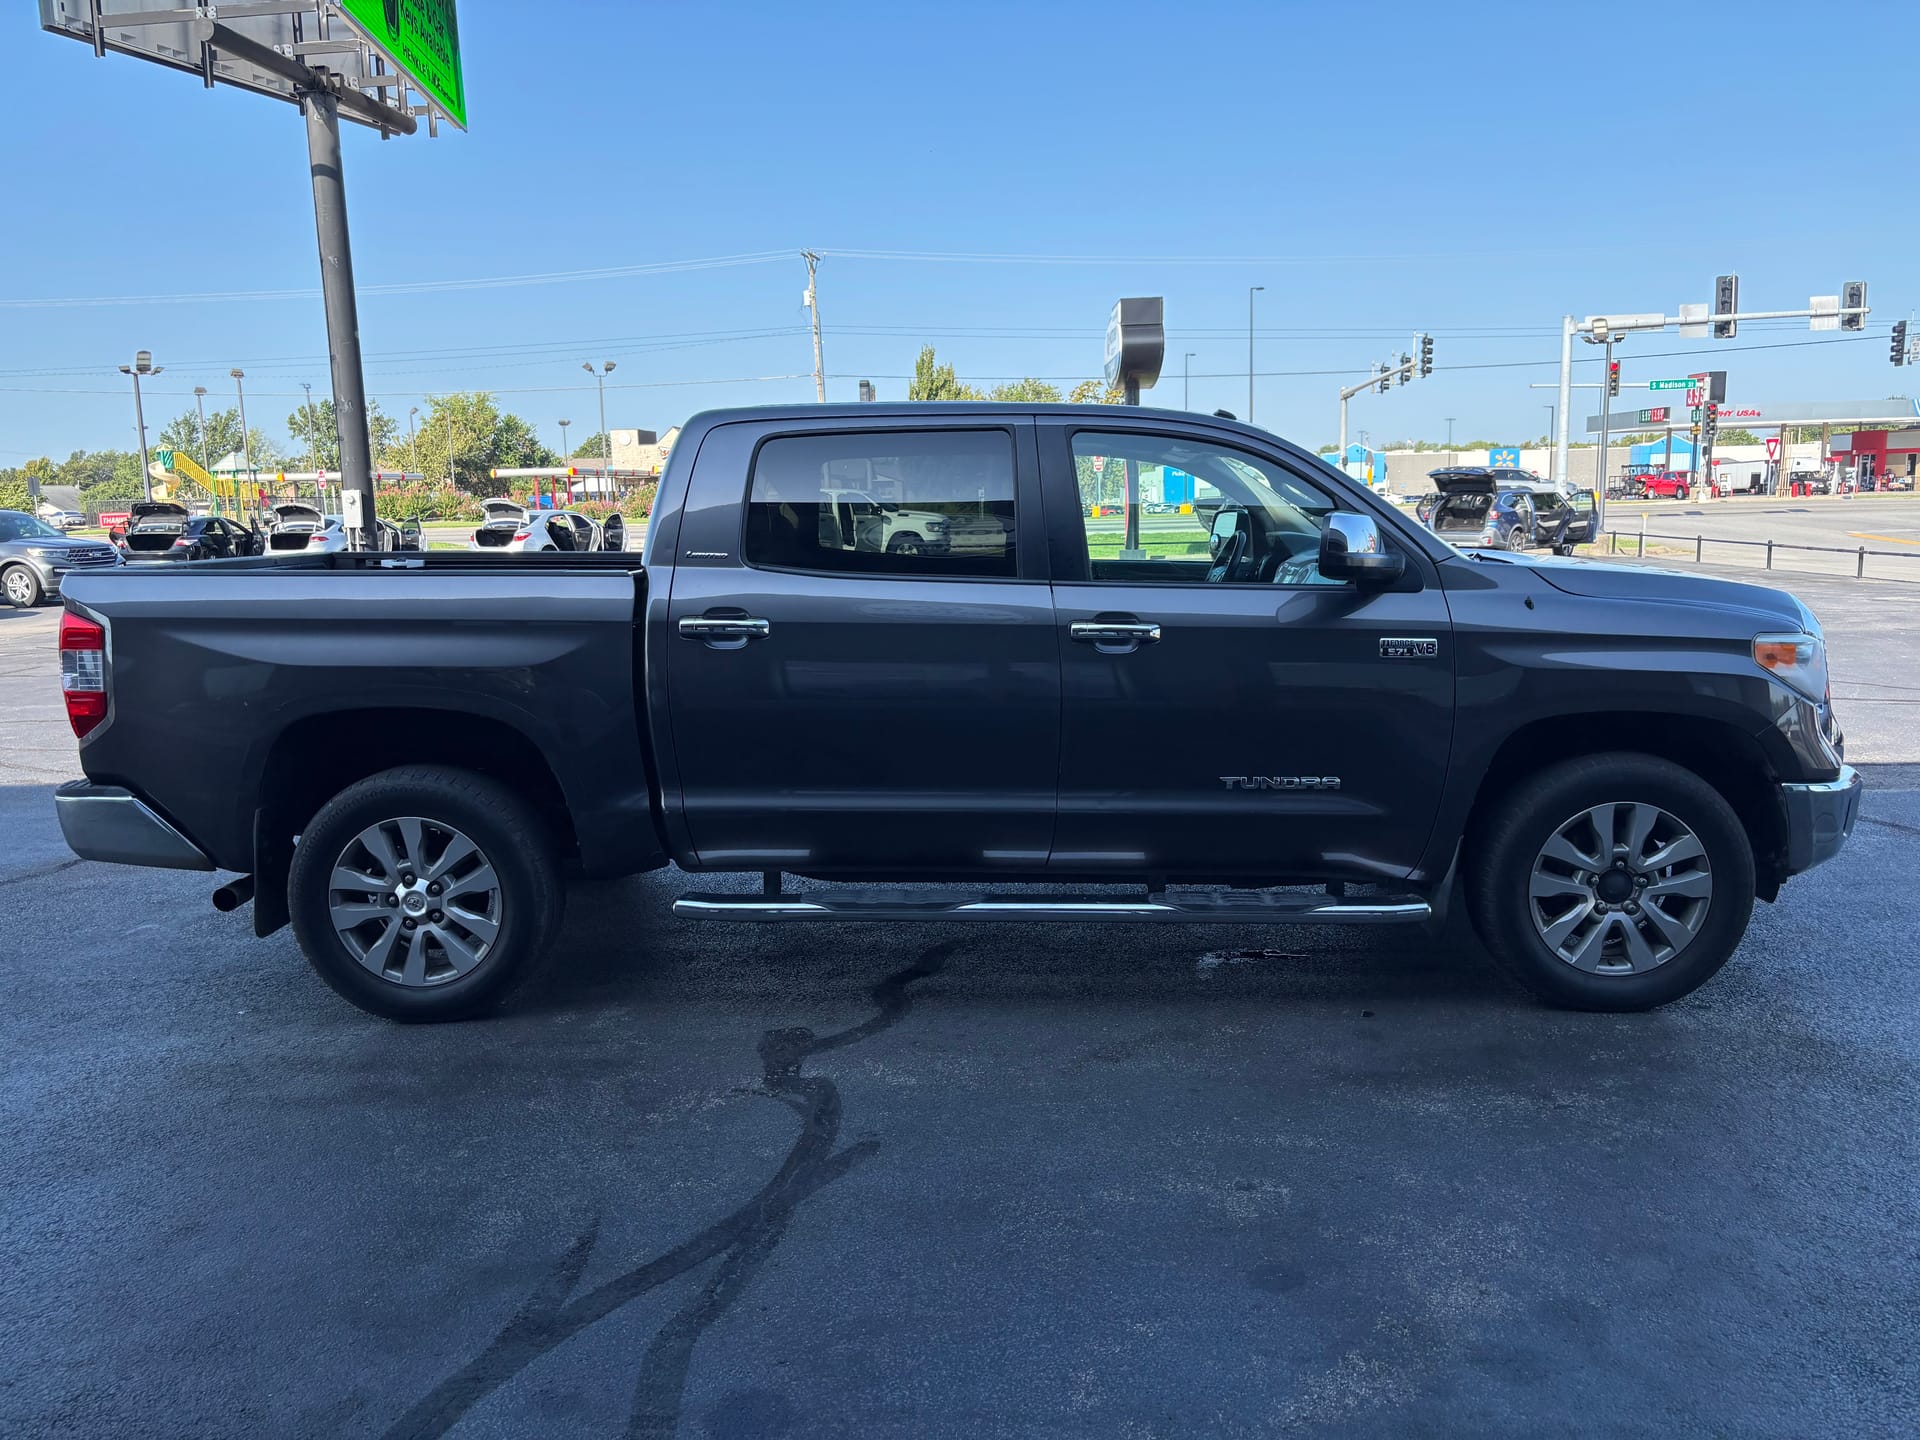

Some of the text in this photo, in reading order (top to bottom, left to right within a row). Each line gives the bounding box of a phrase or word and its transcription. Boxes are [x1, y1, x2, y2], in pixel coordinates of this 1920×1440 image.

[1736, 409, 1755, 417] USA
[1414, 642, 1436, 656] V8
[1219, 776, 1341, 790] TUNDRA
